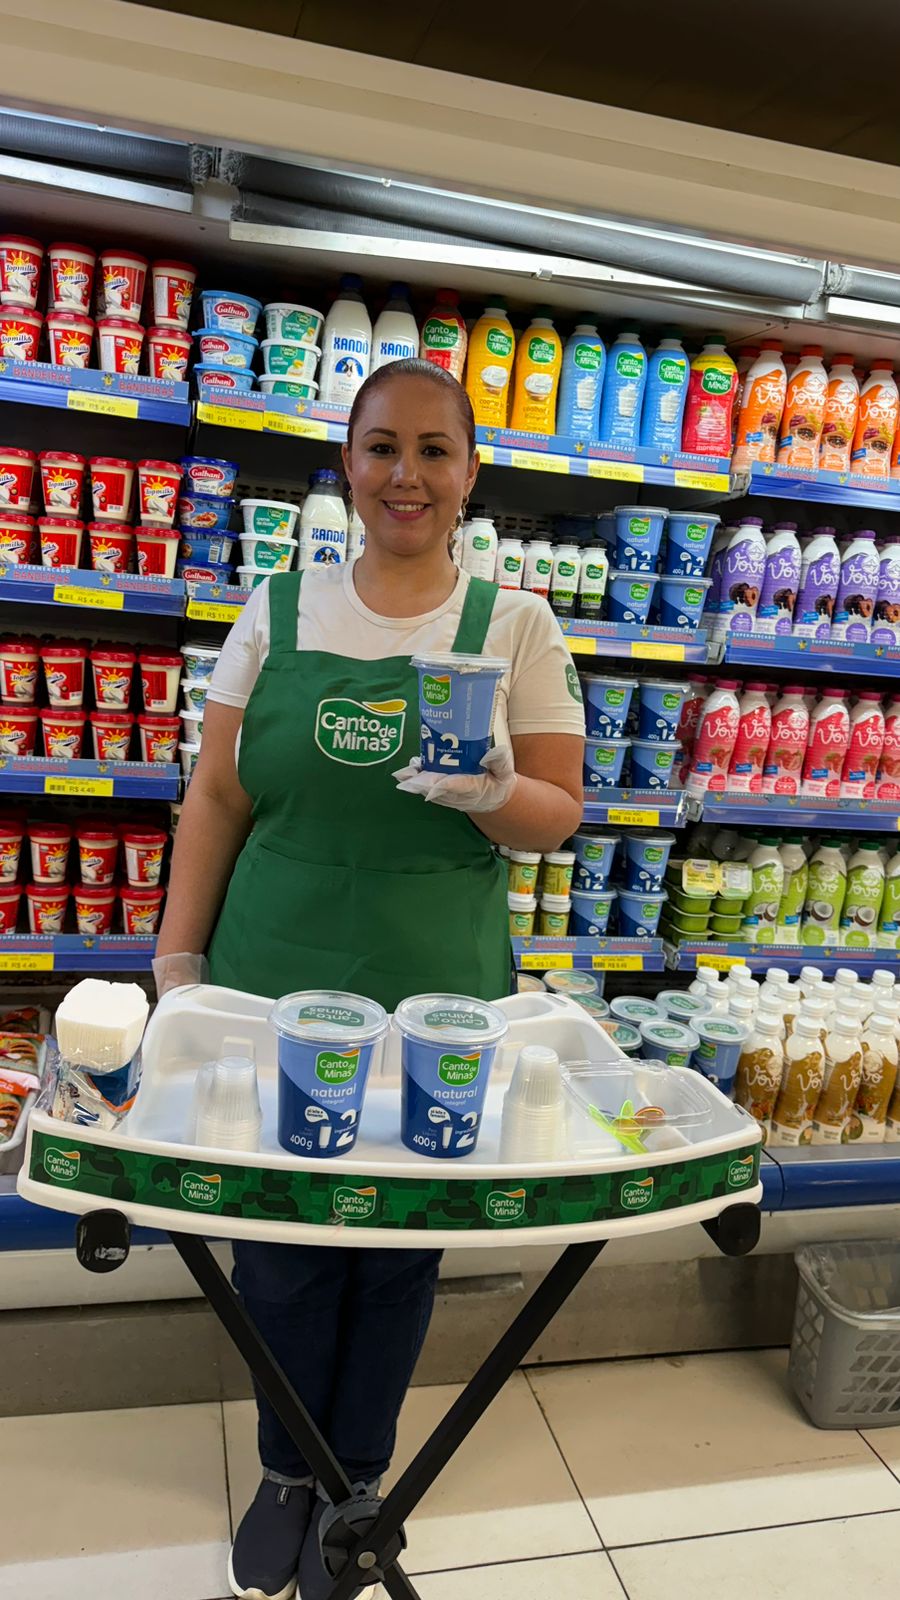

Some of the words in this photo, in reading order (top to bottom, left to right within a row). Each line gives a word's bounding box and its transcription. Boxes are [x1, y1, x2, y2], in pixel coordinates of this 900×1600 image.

[217, 305, 247, 317] Galbani
[426, 325, 449, 336] Canto
[428, 334, 454, 344] Minas
[576, 350, 597, 359] Canto
[13, 360, 72, 373] SUPERMERCADO
[580, 357, 599, 366] Minas
[619, 357, 639, 367] Canto
[622, 365, 641, 374] Minas
[661, 364, 681, 373] Canto
[119, 374, 176, 386] SUPERMERCADO
[663, 371, 683, 380] Minas
[705, 373, 727, 382] Canto
[203, 377, 231, 386] Galbani
[707, 380, 728, 390] Minas
[501, 430, 550, 440] SUPERMERCADO
[190, 468, 221, 481] Galbani
[14, 564, 70, 574] SUPERMERCADO
[117, 574, 172, 584] SUPERMERCADO
[184, 572, 213, 582] Galbani
[424, 682, 441, 691] Canto
[426, 691, 445, 700] Minas
[421, 708, 452, 719] natural
[321, 712, 380, 731] Canto
[379, 724, 397, 738] de
[332, 730, 391, 751] Minas
[440, 733, 460, 766] 2
[309, 1007, 352, 1017] Minas
[316, 1012, 361, 1023] Canto
[441, 1016, 484, 1025] Canto
[319, 1059, 348, 1069] Canto
[442, 1062, 470, 1071] Canto
[324, 1069, 352, 1079] Minas
[446, 1072, 473, 1080] Minas
[310, 1084, 357, 1098] natural
[433, 1085, 478, 1099] natural
[335, 1108, 357, 1148] 2
[455, 1111, 478, 1148] 2
[47, 1154, 70, 1166] Canto
[50, 1165, 74, 1176] Minas
[731, 1166, 747, 1175] Canto
[733, 1173, 749, 1182] Minas
[184, 1180, 210, 1191] Canto
[188, 1190, 214, 1201] Minas
[624, 1188, 644, 1197] Canto
[337, 1195, 364, 1204] Canto
[490, 1199, 515, 1207] Canto
[627, 1196, 647, 1204] Minas
[341, 1204, 368, 1213] Minas
[494, 1207, 519, 1216] Minas
